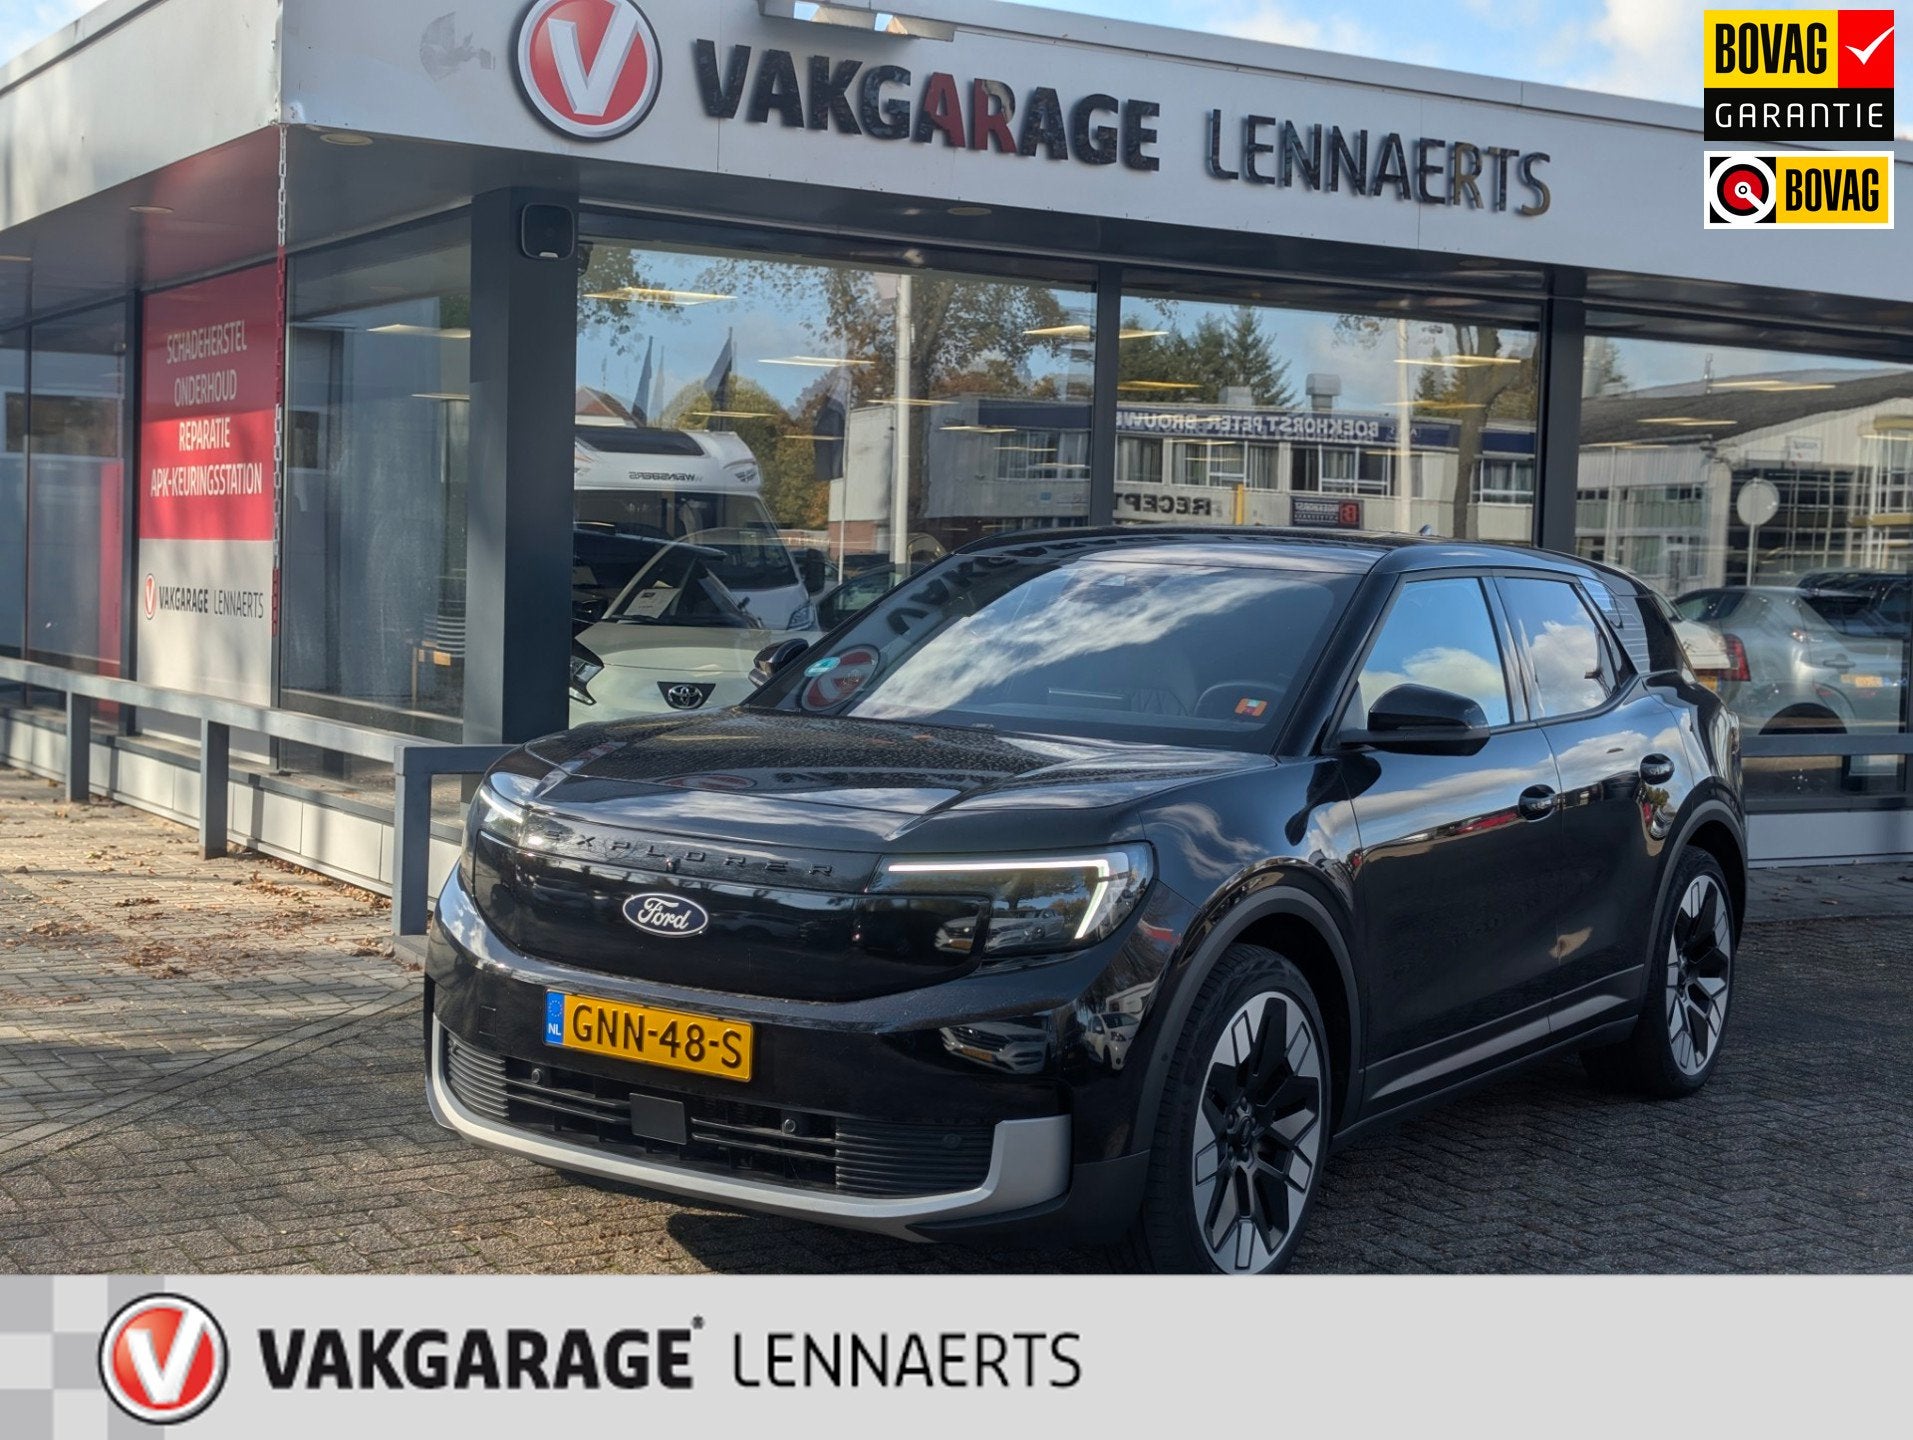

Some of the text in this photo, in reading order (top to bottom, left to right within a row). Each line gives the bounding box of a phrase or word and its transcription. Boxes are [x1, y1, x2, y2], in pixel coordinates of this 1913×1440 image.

[696, 38, 1160, 171] VAKGARAGE
[1206, 108, 1552, 216] LENNAERTS
[166, 320, 248, 364] SCHADEHERSTEL
[174, 369, 237, 407] ONDERHOUD
[179, 417, 231, 451] REPARATIE
[150, 463, 262, 497] APK-KEURINGSSTATION
[159, 586, 208, 613] VAKGARAGE
[213, 590, 264, 619] LENNAERTS
[546, 830, 834, 877] EXPLORER
[637, 897, 690, 931] Ford
[548, 1004, 743, 1069] NL GNN-48-S
